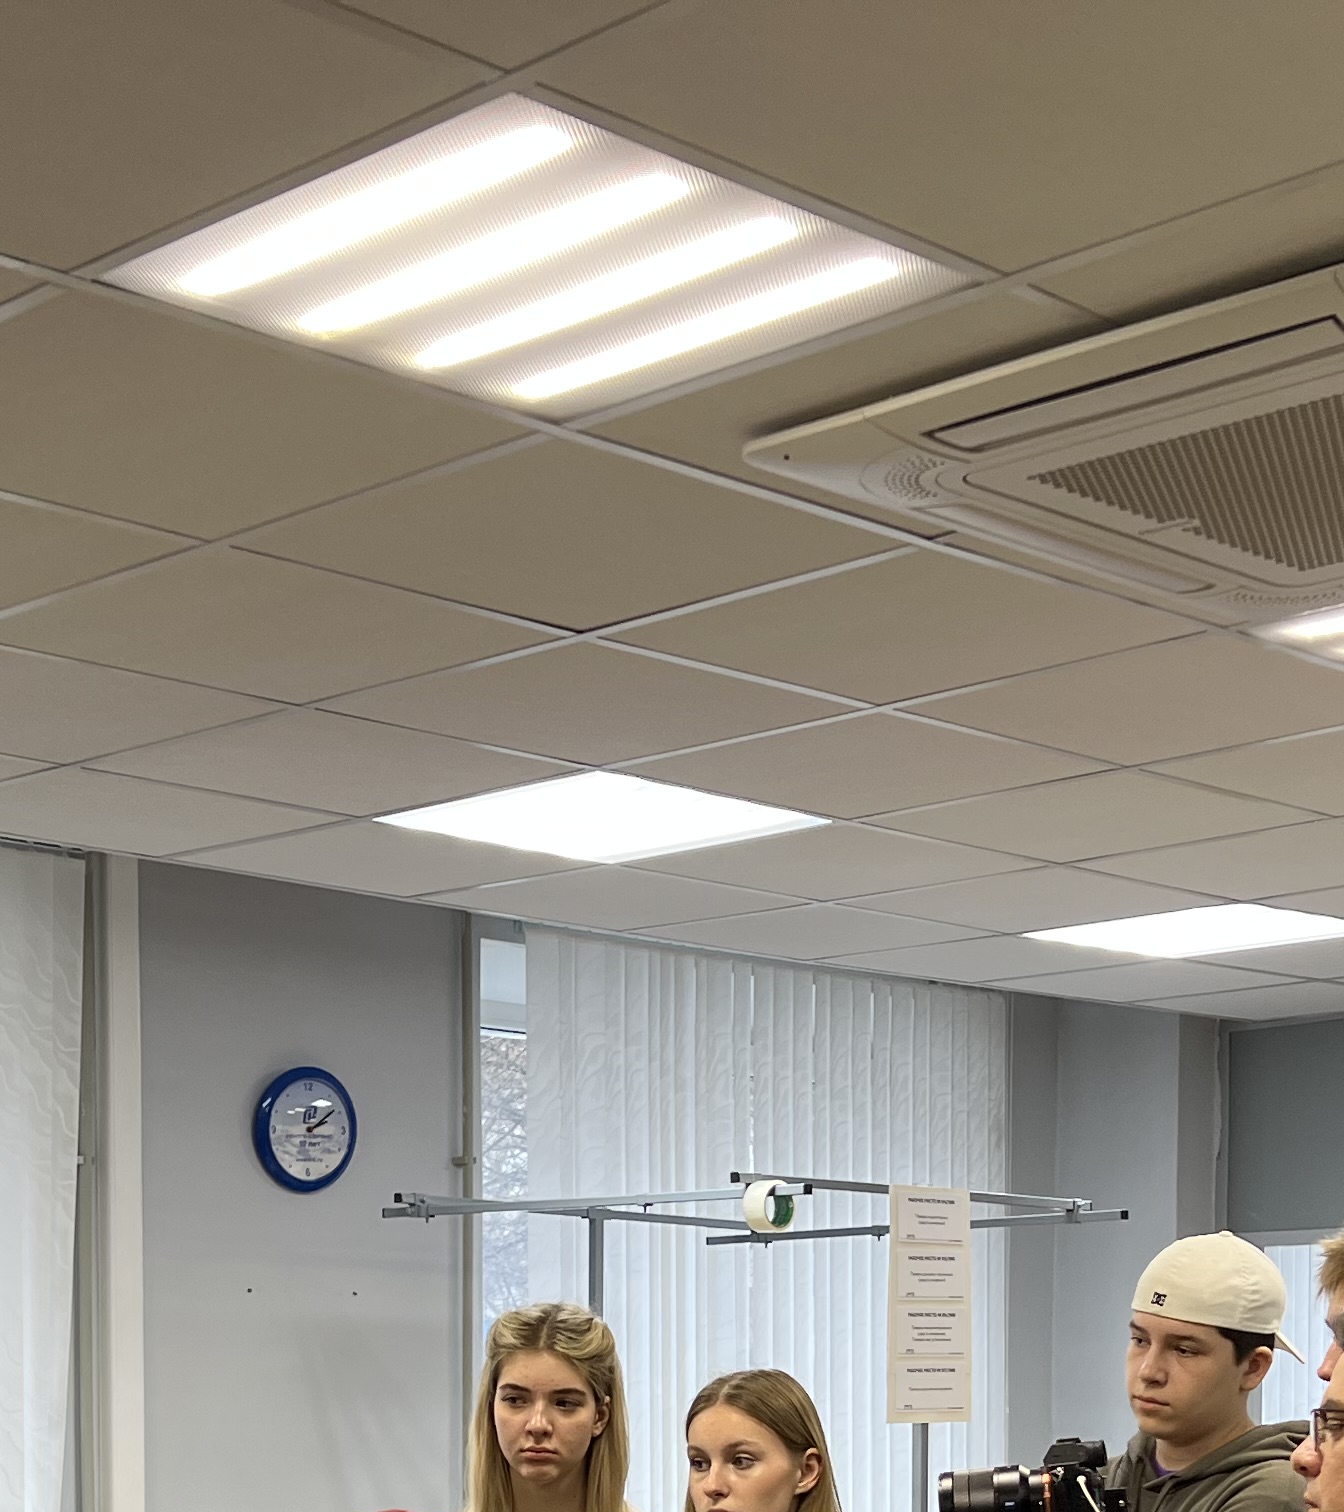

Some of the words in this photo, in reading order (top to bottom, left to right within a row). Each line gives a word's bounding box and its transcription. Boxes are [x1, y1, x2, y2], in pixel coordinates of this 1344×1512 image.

[304, 1082, 313, 1091] 12
[341, 1125, 346, 1135] 3
[305, 1167, 311, 1177] 6
